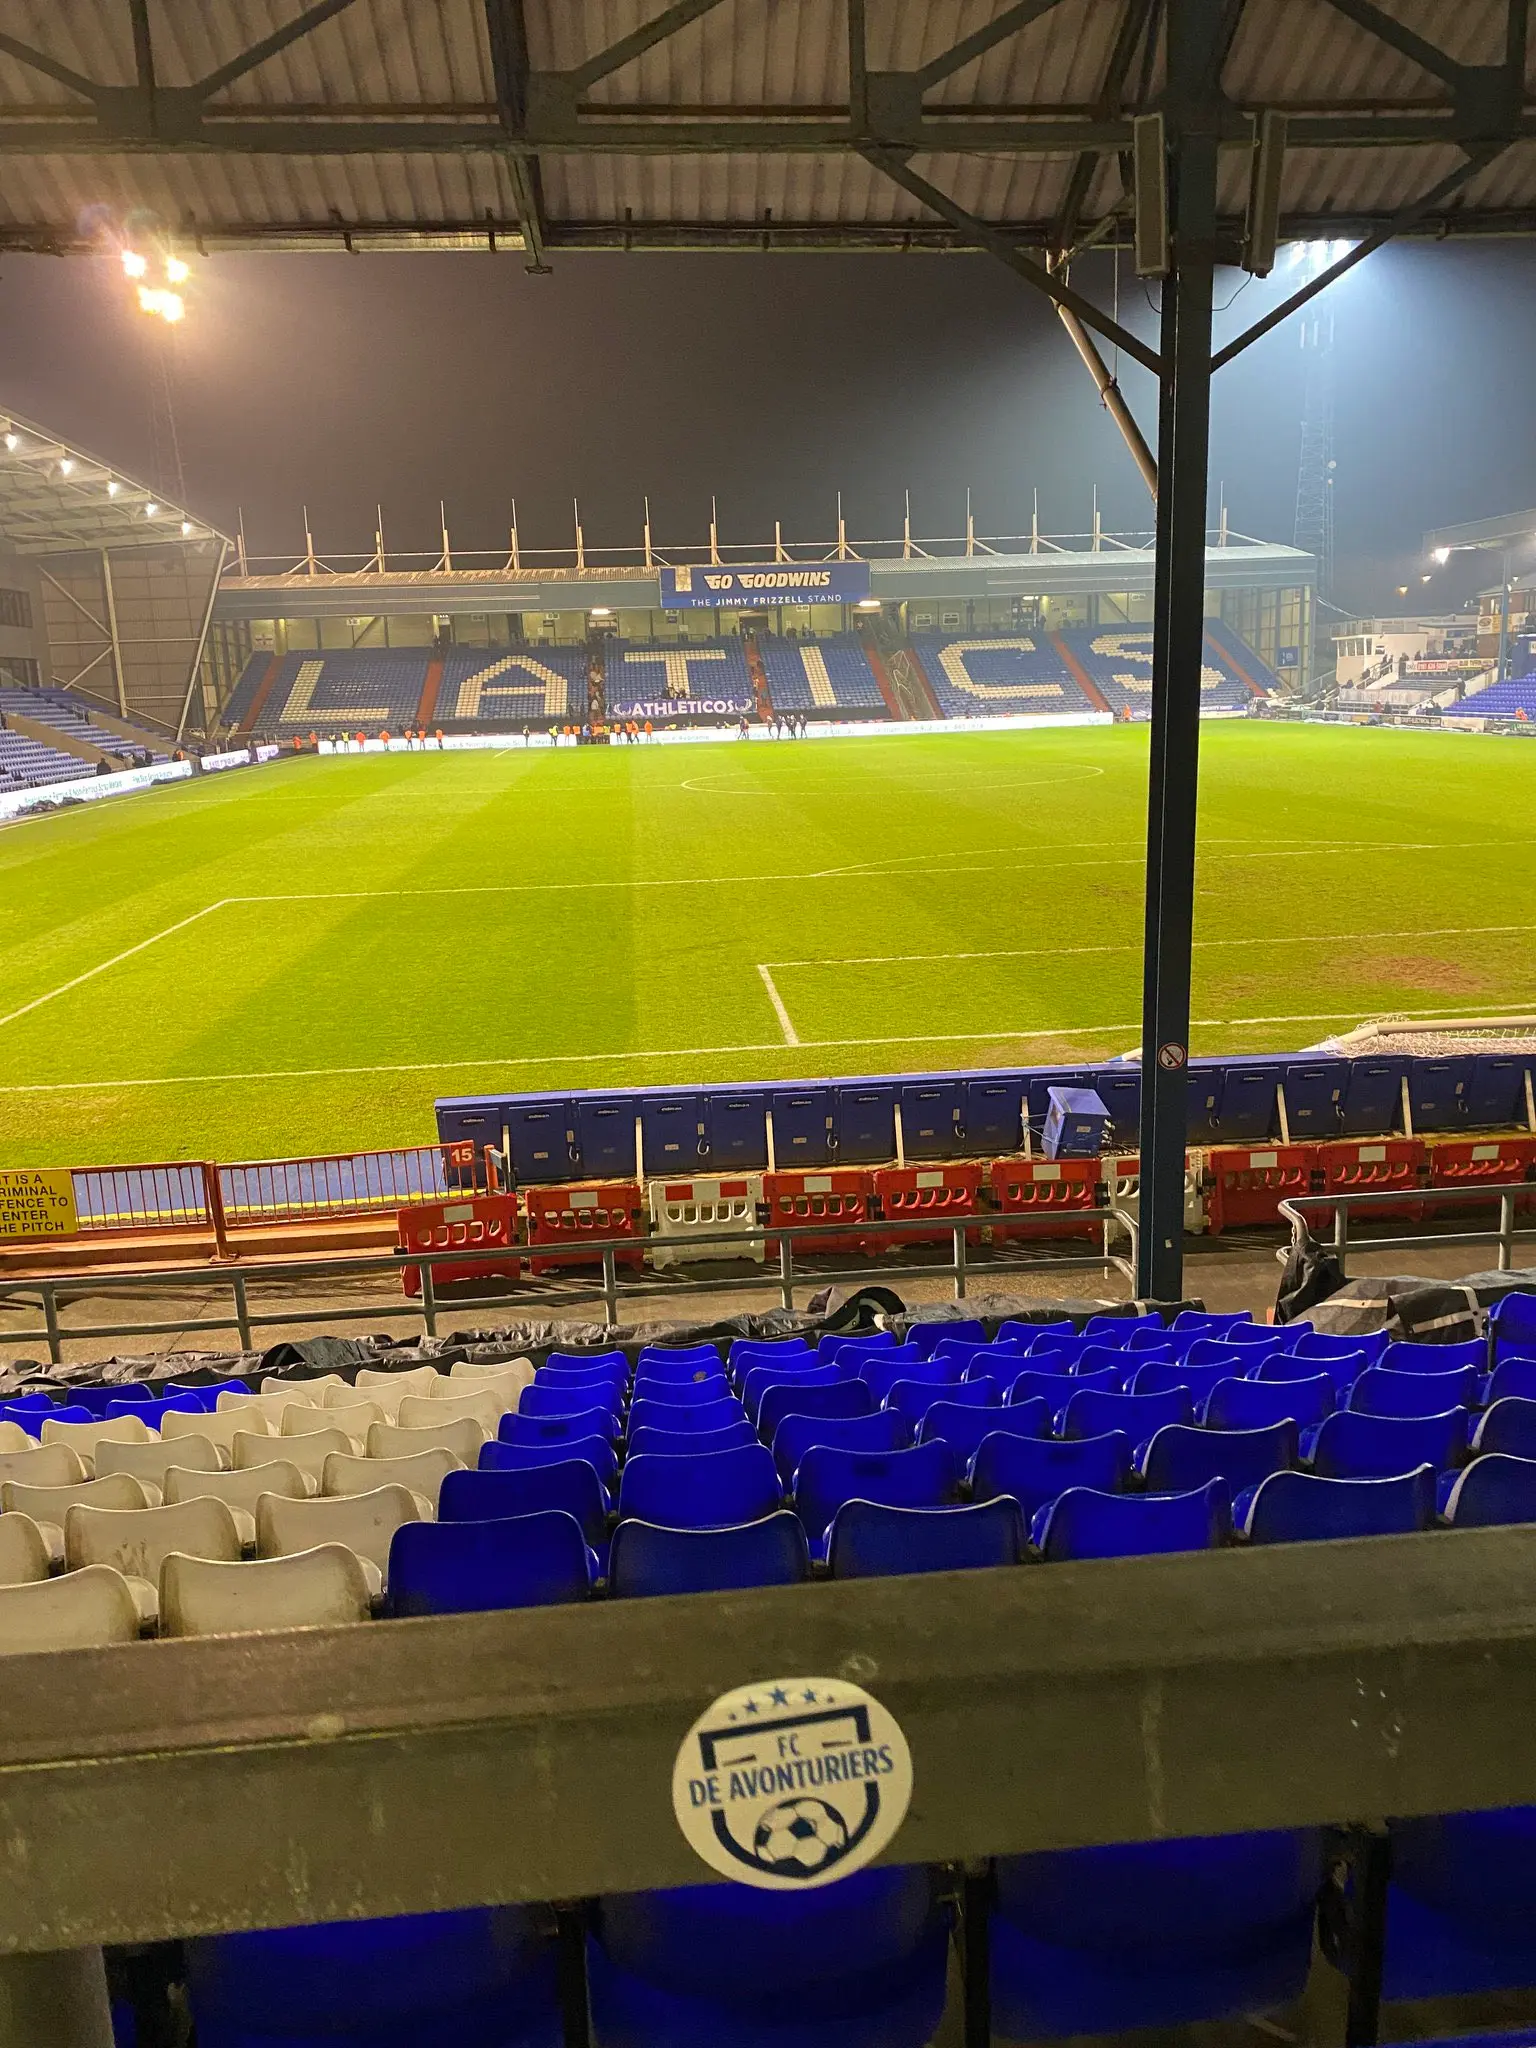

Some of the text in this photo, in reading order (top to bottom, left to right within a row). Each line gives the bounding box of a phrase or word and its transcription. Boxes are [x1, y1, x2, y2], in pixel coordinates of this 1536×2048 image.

[704, 571, 831, 590] GO GOODWINS
[691, 594, 842, 607] THE JIMMY FRIZZELL STAND
[632, 699, 736, 716] ATHLETICOS
[450, 1147, 472, 1163] 15
[15, 1174, 29, 1185] IS
[33, 1173, 43, 1184] A
[0, 1185, 57, 1197] RIMINAL
[0, 1197, 69, 1209] FENCE TO
[2, 1210, 49, 1221] ENTER
[0, 1221, 65, 1234] HE PITCH
[776, 1733, 802, 1759] FC
[688, 1745, 895, 1808] DE AVONTURIERS
